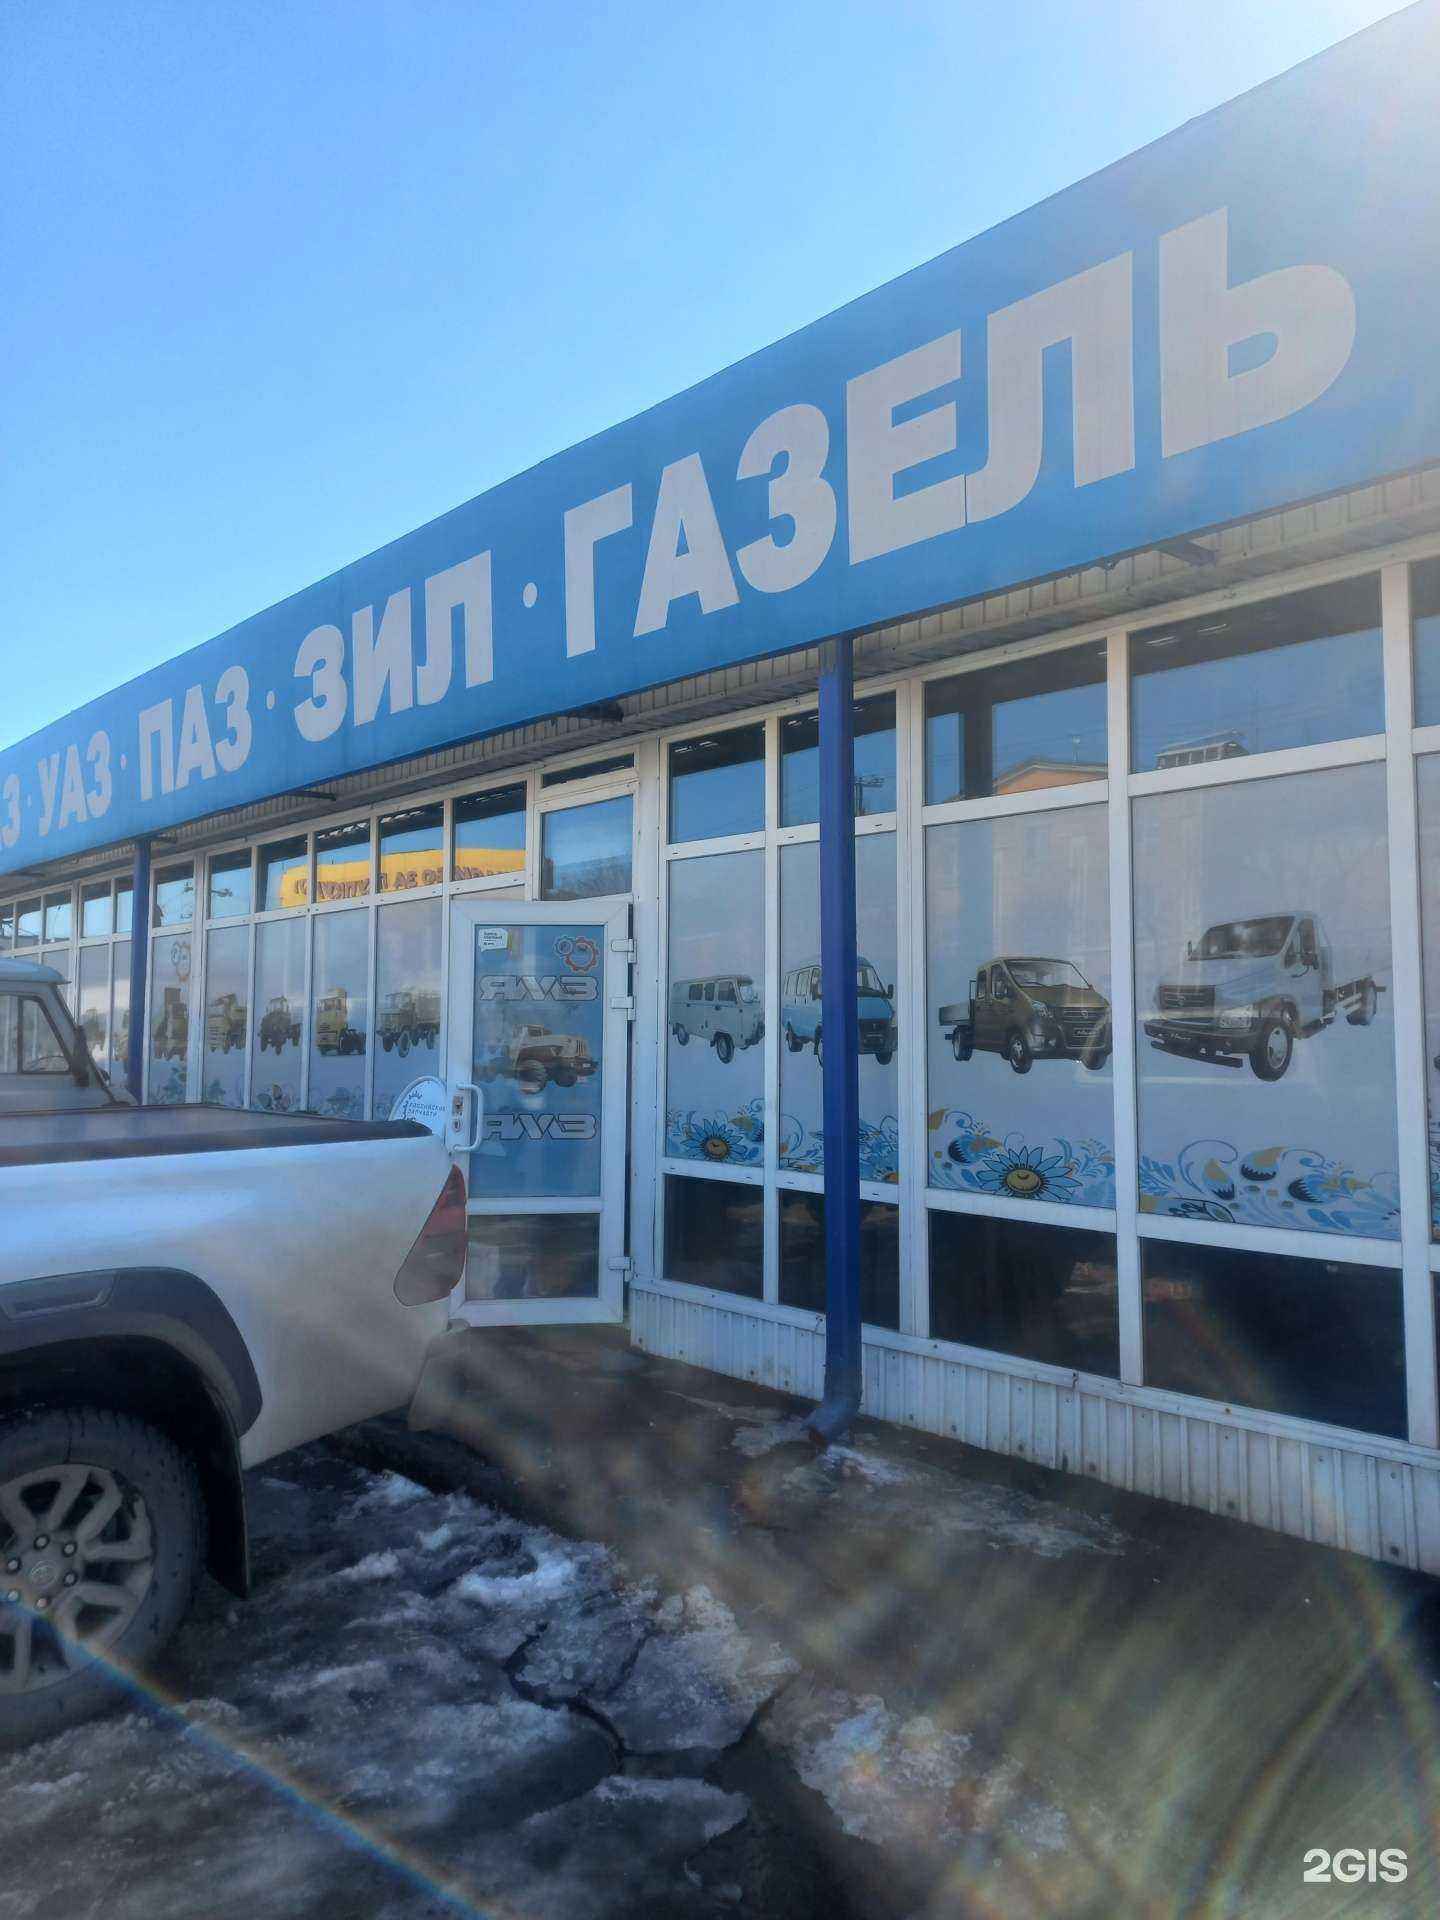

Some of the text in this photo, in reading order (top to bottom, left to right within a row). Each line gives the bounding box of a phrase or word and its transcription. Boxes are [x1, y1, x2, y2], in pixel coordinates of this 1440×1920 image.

[37, 730, 112, 837] УАЗ
[138, 665, 253, 801] ПАЗ
[293, 549, 494, 742] ЗИЛ
[564, 206, 1356, 659] ГАЗЕЛЬ
